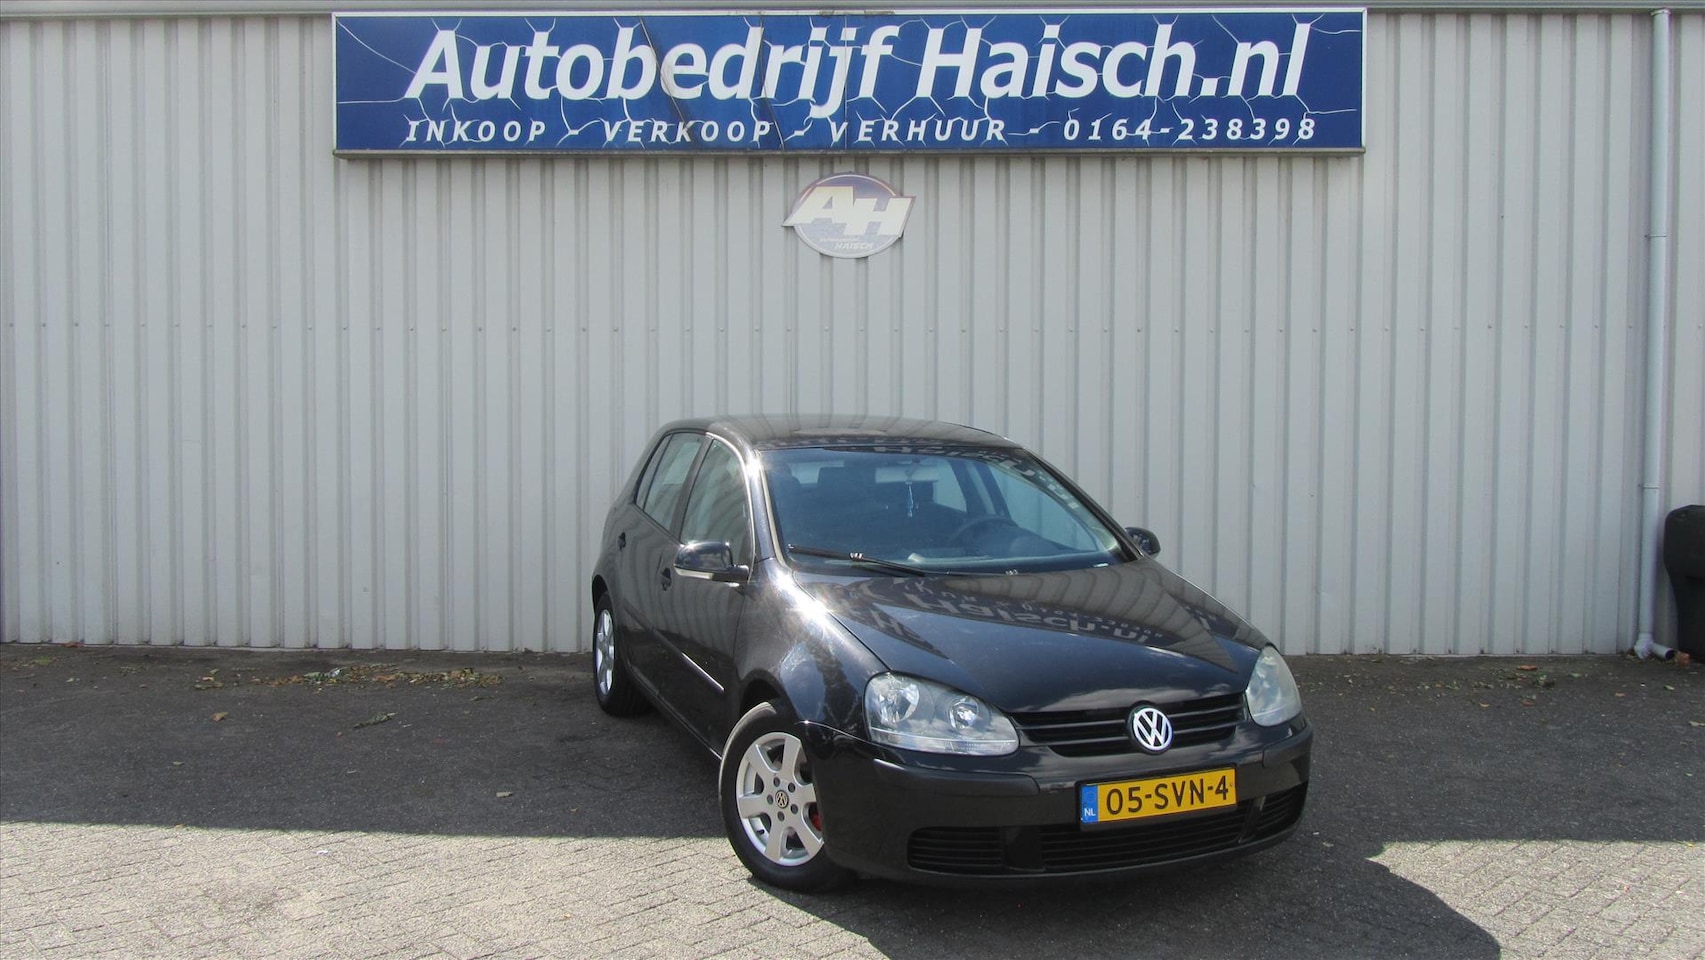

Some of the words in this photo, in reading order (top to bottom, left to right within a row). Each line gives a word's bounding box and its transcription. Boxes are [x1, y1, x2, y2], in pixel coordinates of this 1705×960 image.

[403, 25, 900, 118] Autobedrijf
[914, 23, 1311, 99] Haisch.nl
[406, 119, 547, 142] INKOOP
[604, 119, 772, 142] VERKOOP
[829, 119, 1006, 142] VERHUUR
[1063, 118, 1316, 142] 0164-238398
[781, 186, 913, 237] AH
[1084, 807, 1096, 817] NL
[1106, 775, 1229, 815] 05-SVN-4
